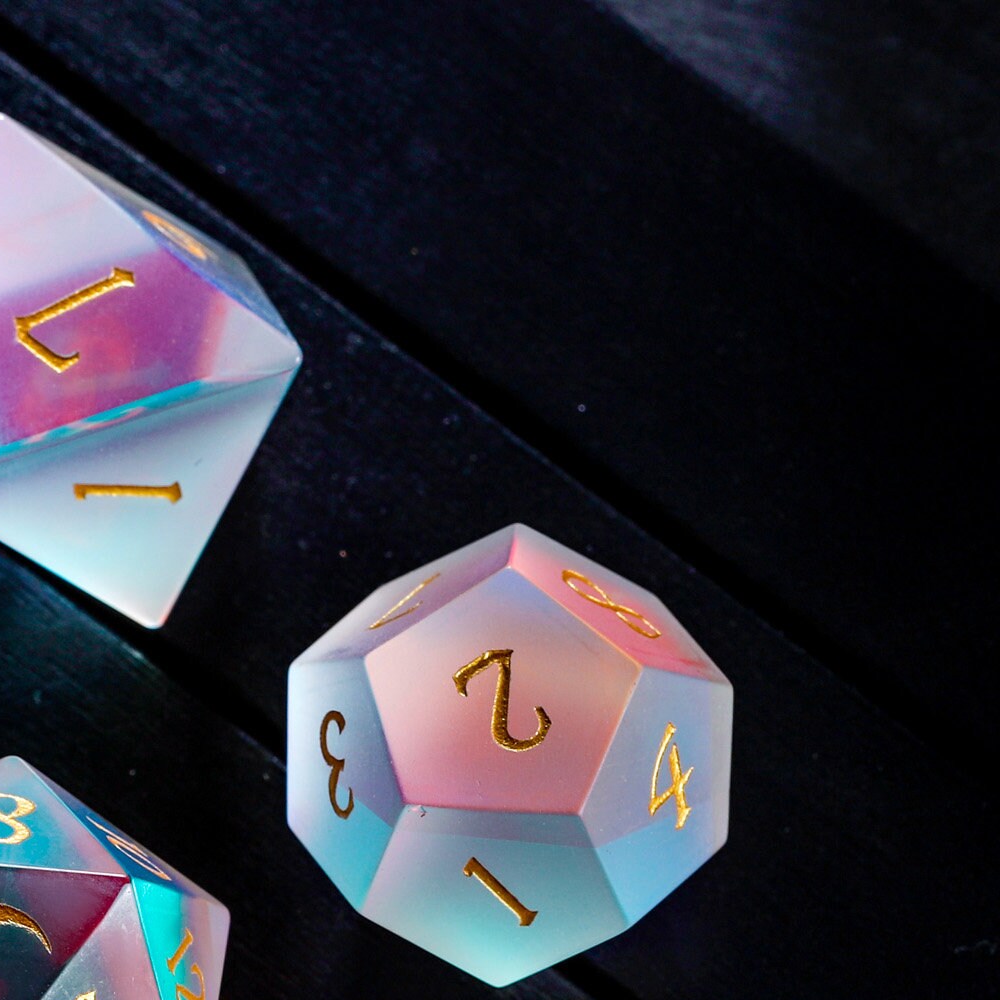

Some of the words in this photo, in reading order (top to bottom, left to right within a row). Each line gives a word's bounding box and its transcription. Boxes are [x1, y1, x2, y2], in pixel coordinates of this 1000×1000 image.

[14, 266, 136, 373] 7
[73, 481, 182, 504] 1
[562, 569, 661, 639] 8
[452, 648, 552, 752] 2
[319, 710, 354, 819] 3
[648, 722, 694, 830] 4
[463, 857, 539, 927] 1
